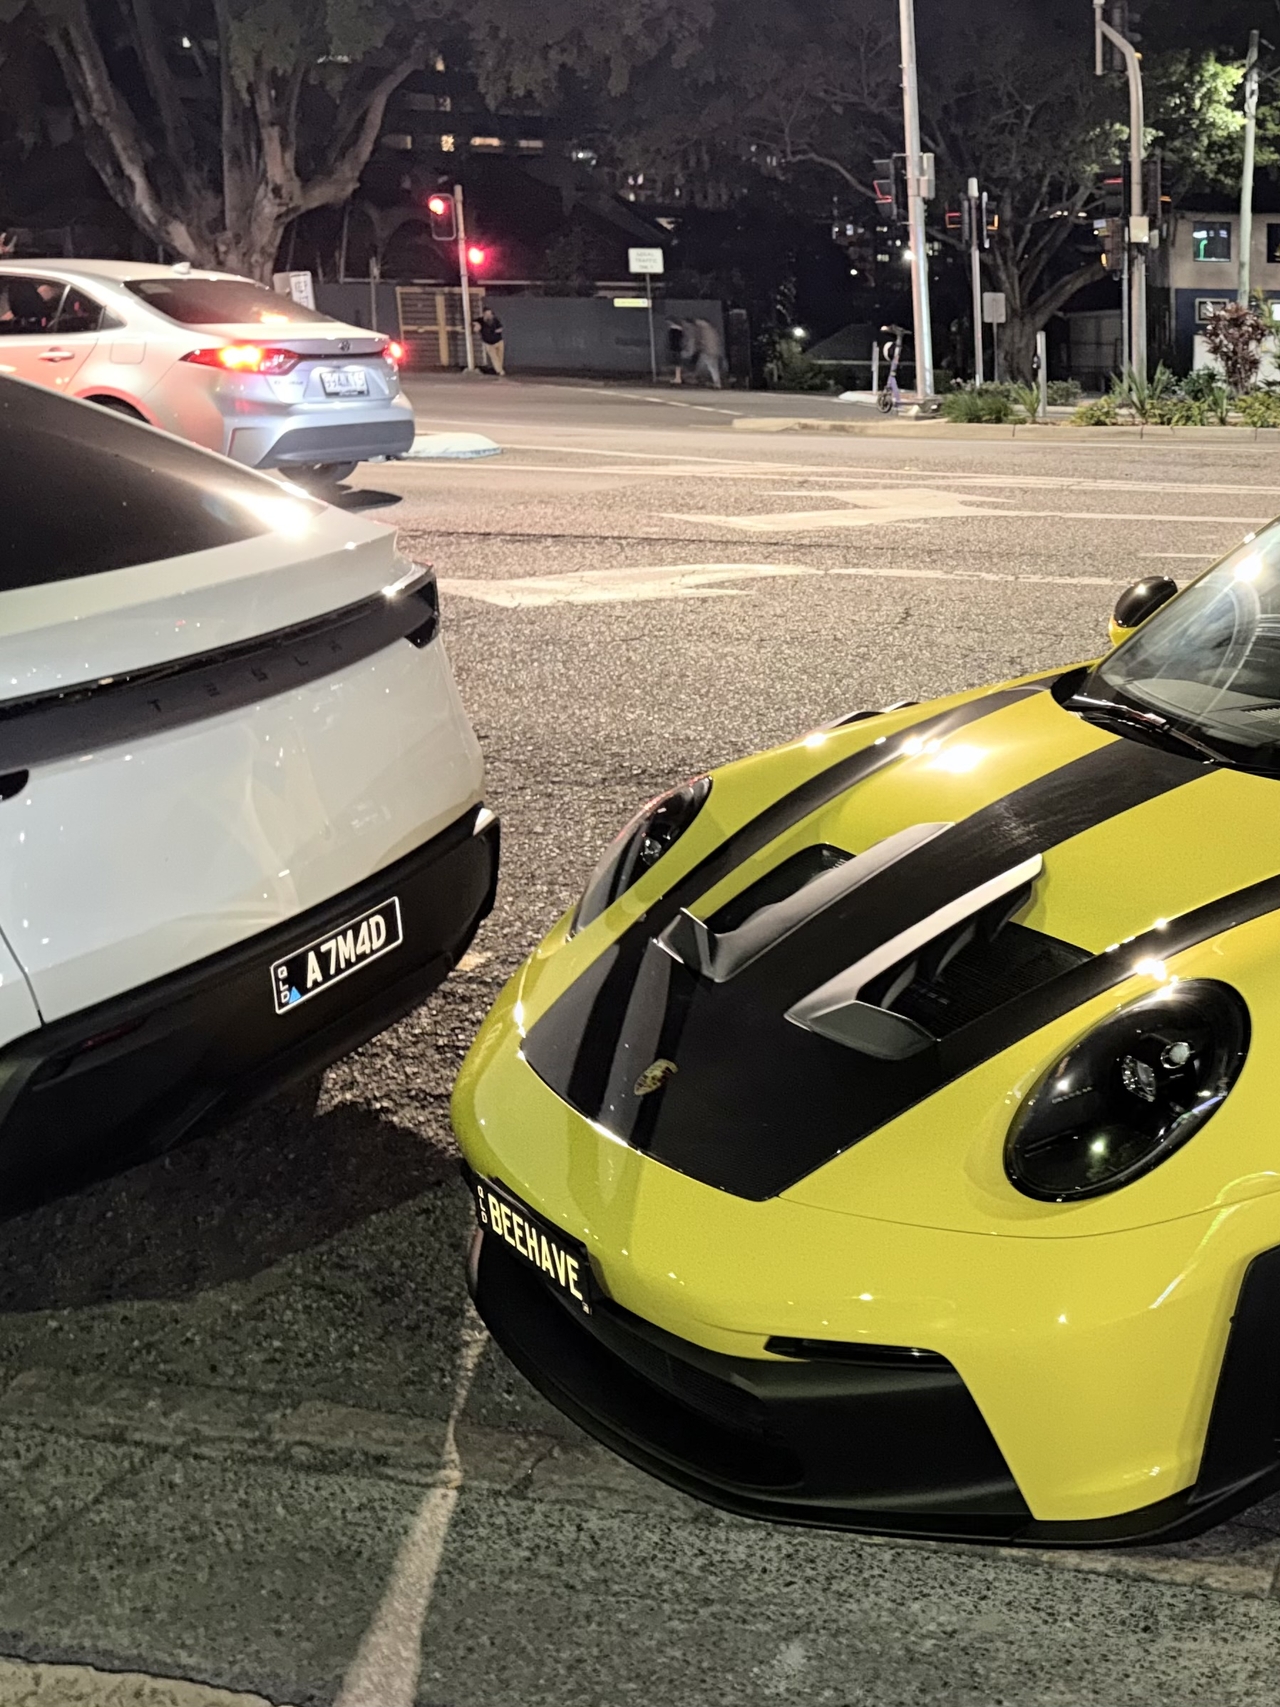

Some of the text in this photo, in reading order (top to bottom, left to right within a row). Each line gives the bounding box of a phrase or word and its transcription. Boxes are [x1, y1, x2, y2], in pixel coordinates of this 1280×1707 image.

[148, 639, 343, 713] TESLA
[320, 914, 386, 976] 7M4D
[277, 965, 290, 1004] QLD
[487, 1192, 584, 1301] BEEHAVE
